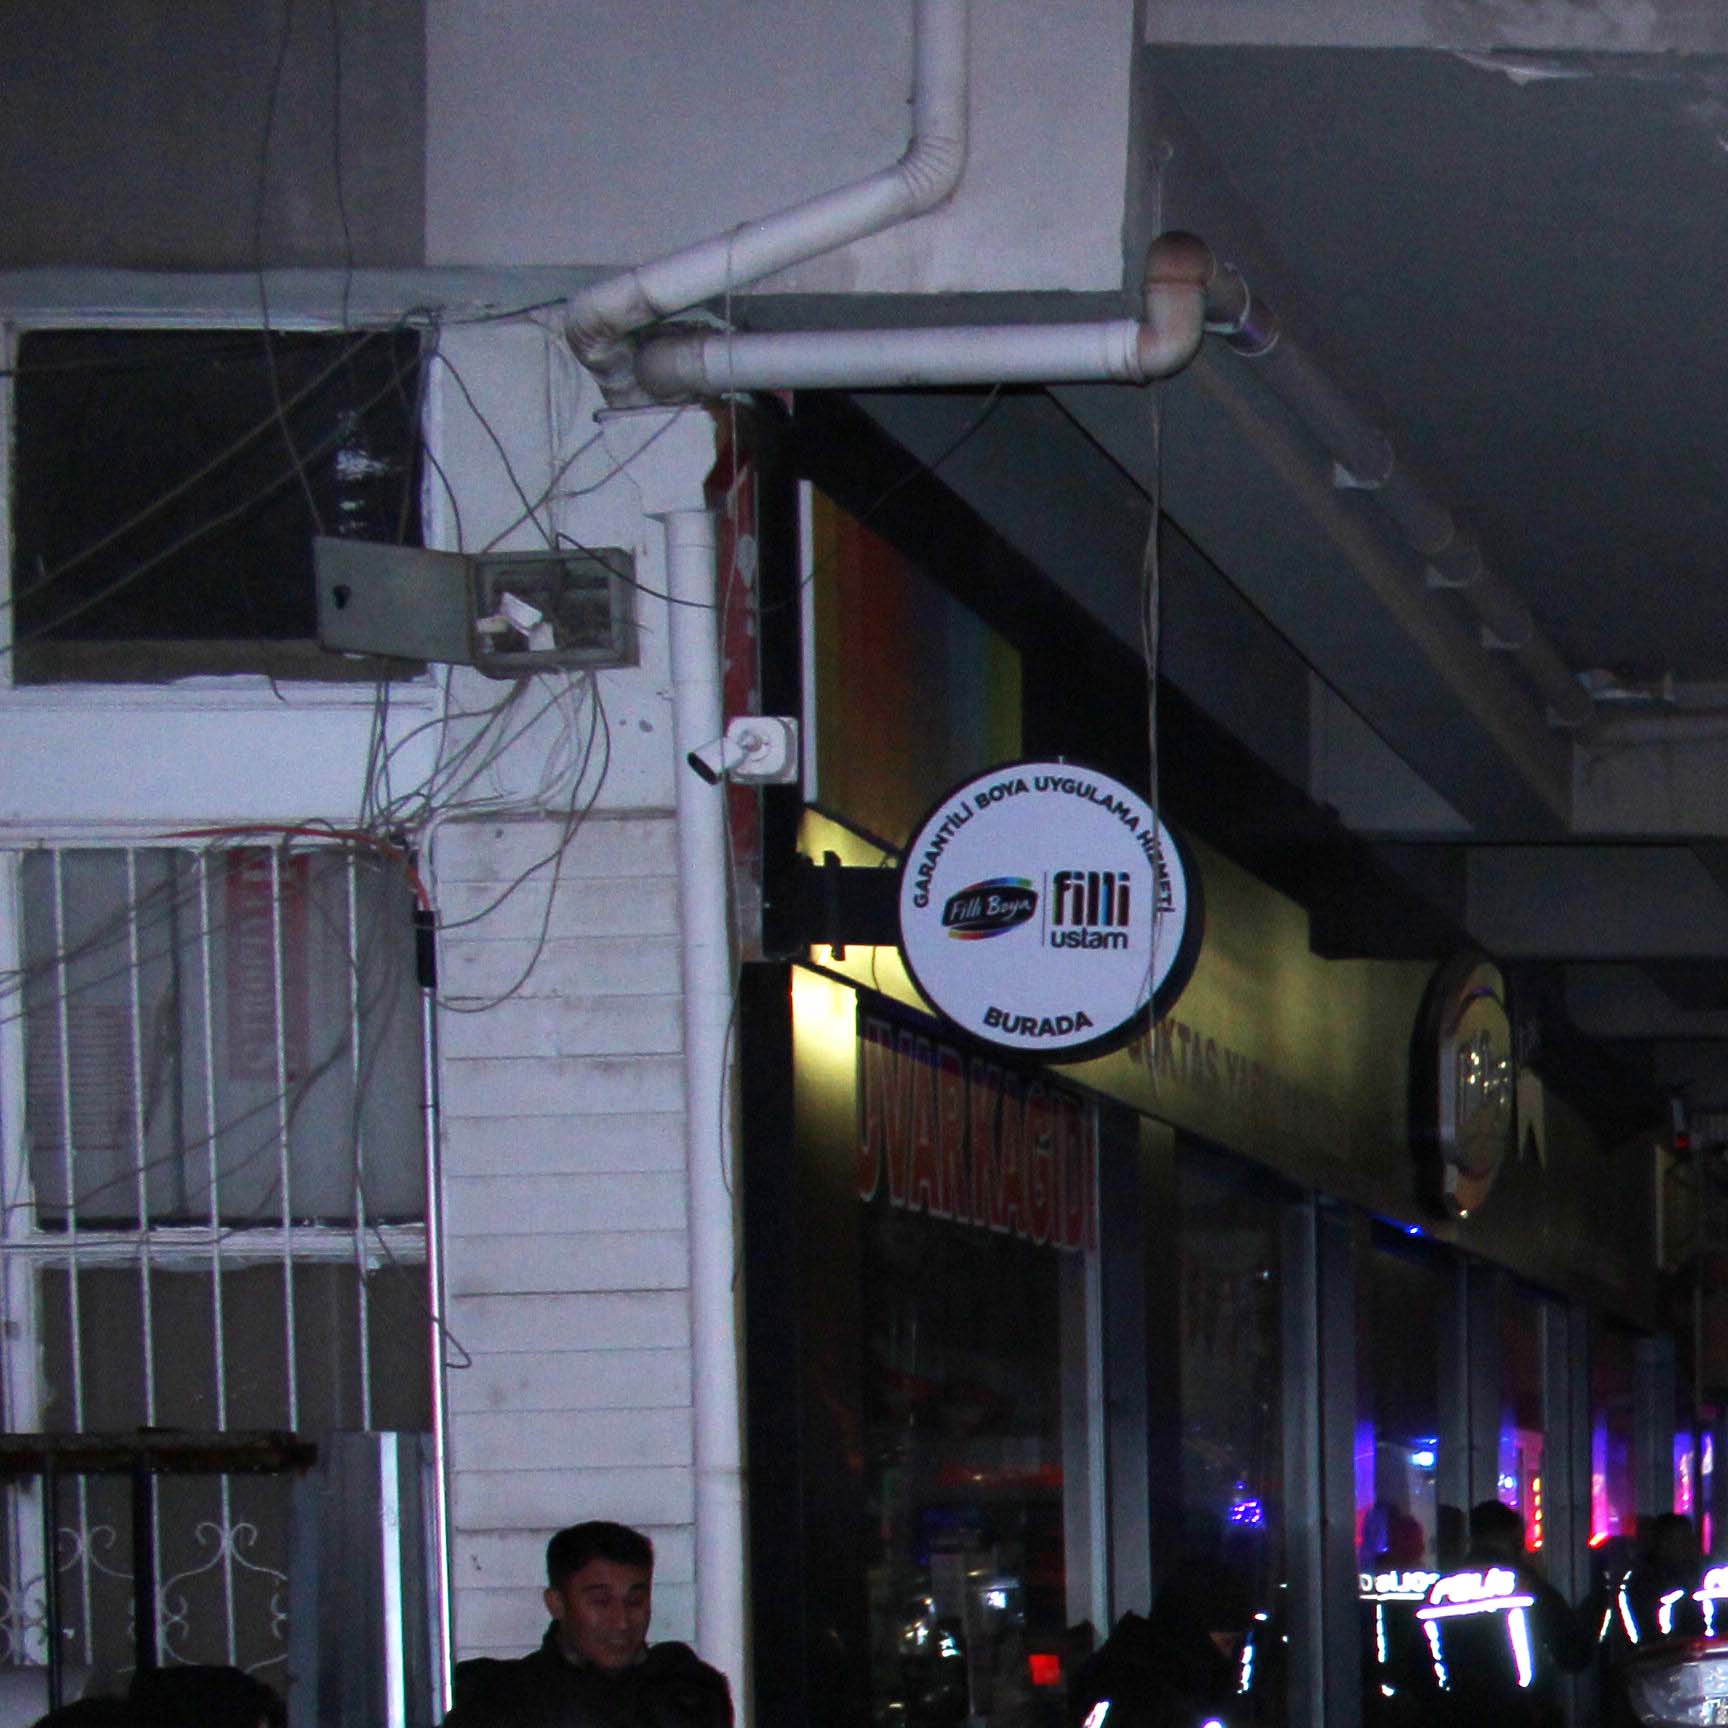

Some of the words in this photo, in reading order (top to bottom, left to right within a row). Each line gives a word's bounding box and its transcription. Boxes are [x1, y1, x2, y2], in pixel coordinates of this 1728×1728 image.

[913, 802, 974, 908] GARANTİLİ
[974, 778, 1029, 811] BOYA
[1034, 776, 1140, 832] UYGULAMA
[984, 894, 1033, 922] Boya
[1052, 870, 1131, 927] filli
[1051, 927, 1129, 950] ustam
[983, 1006, 1094, 1037] BURADA
